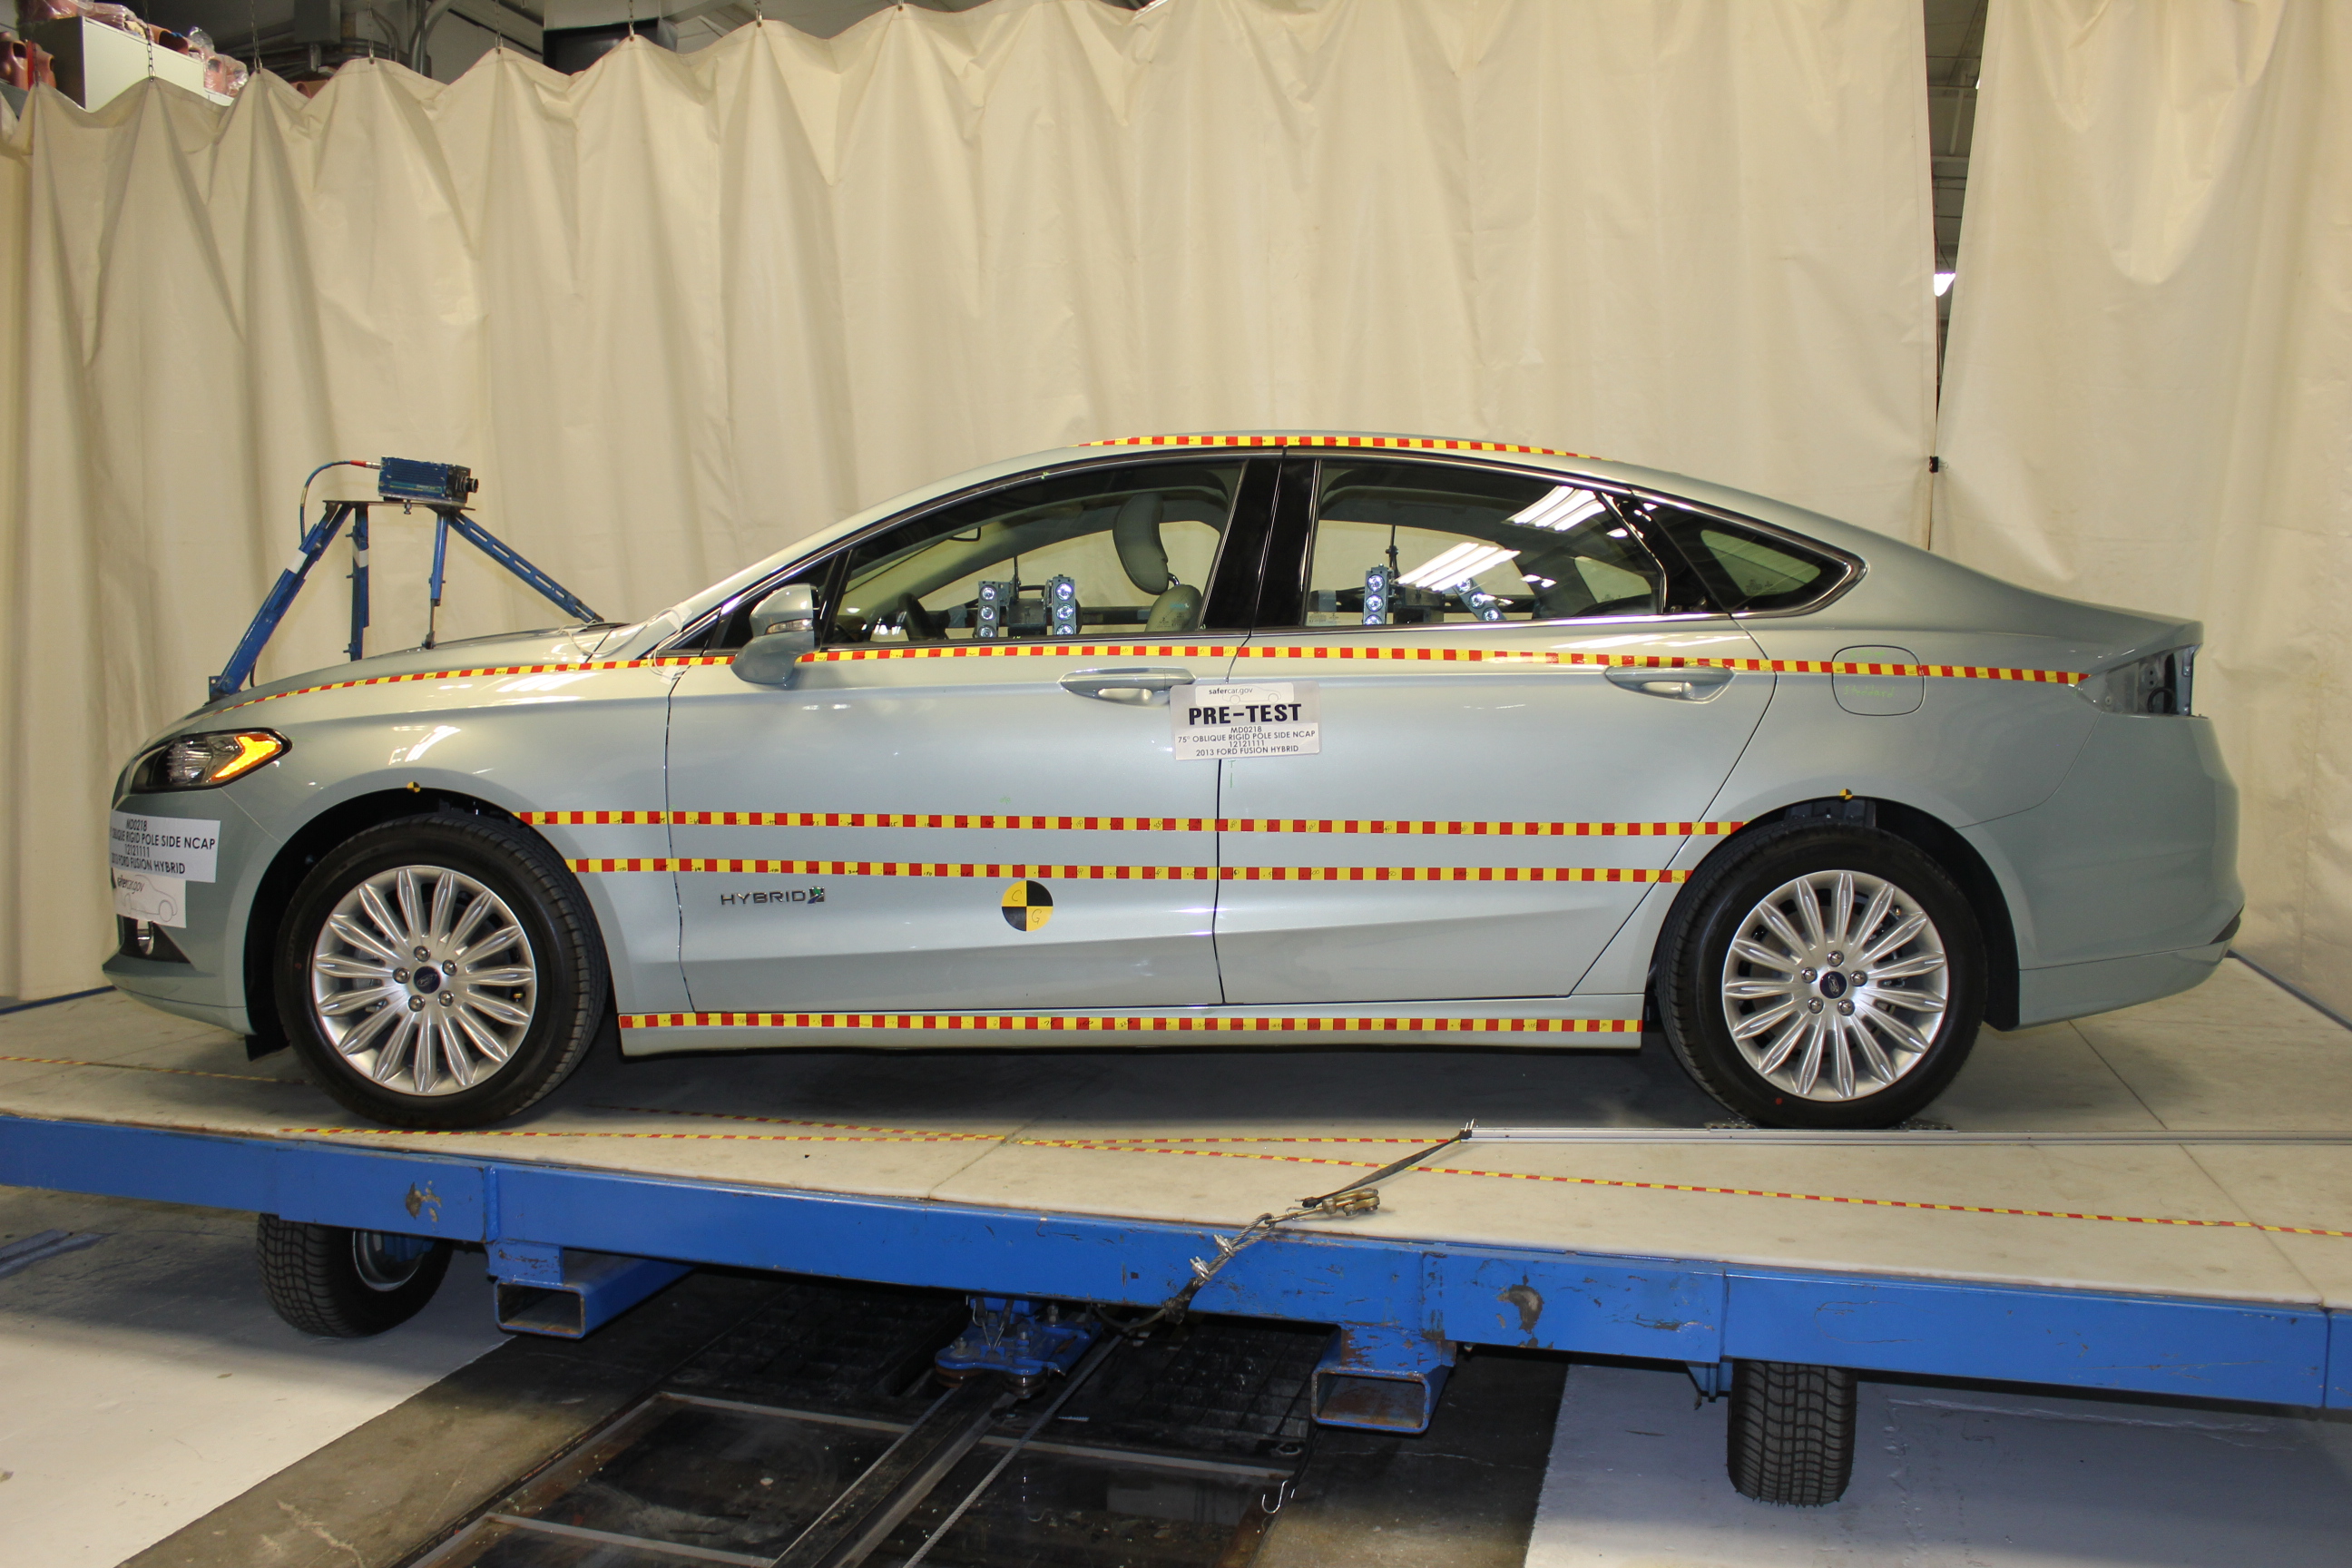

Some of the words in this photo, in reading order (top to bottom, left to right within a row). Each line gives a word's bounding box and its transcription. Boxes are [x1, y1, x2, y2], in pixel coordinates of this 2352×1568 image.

[1209, 687, 1253, 696] safercar.gov
[1189, 703, 1302, 725] PRE-TEST
[1192, 734, 1226, 742] OBLIQUE
[1229, 740, 1265, 748] 12121111
[1270, 745, 1299, 753] HYBRID
[142, 833, 159, 846] POLE
[162, 835, 181, 848] SIDE
[184, 837, 216, 850] NCAP
[153, 860, 186, 874] HYBRID
[720, 890, 806, 906] HYBRID
[1011, 889, 1022, 901] C
[1031, 908, 1042, 925] G
